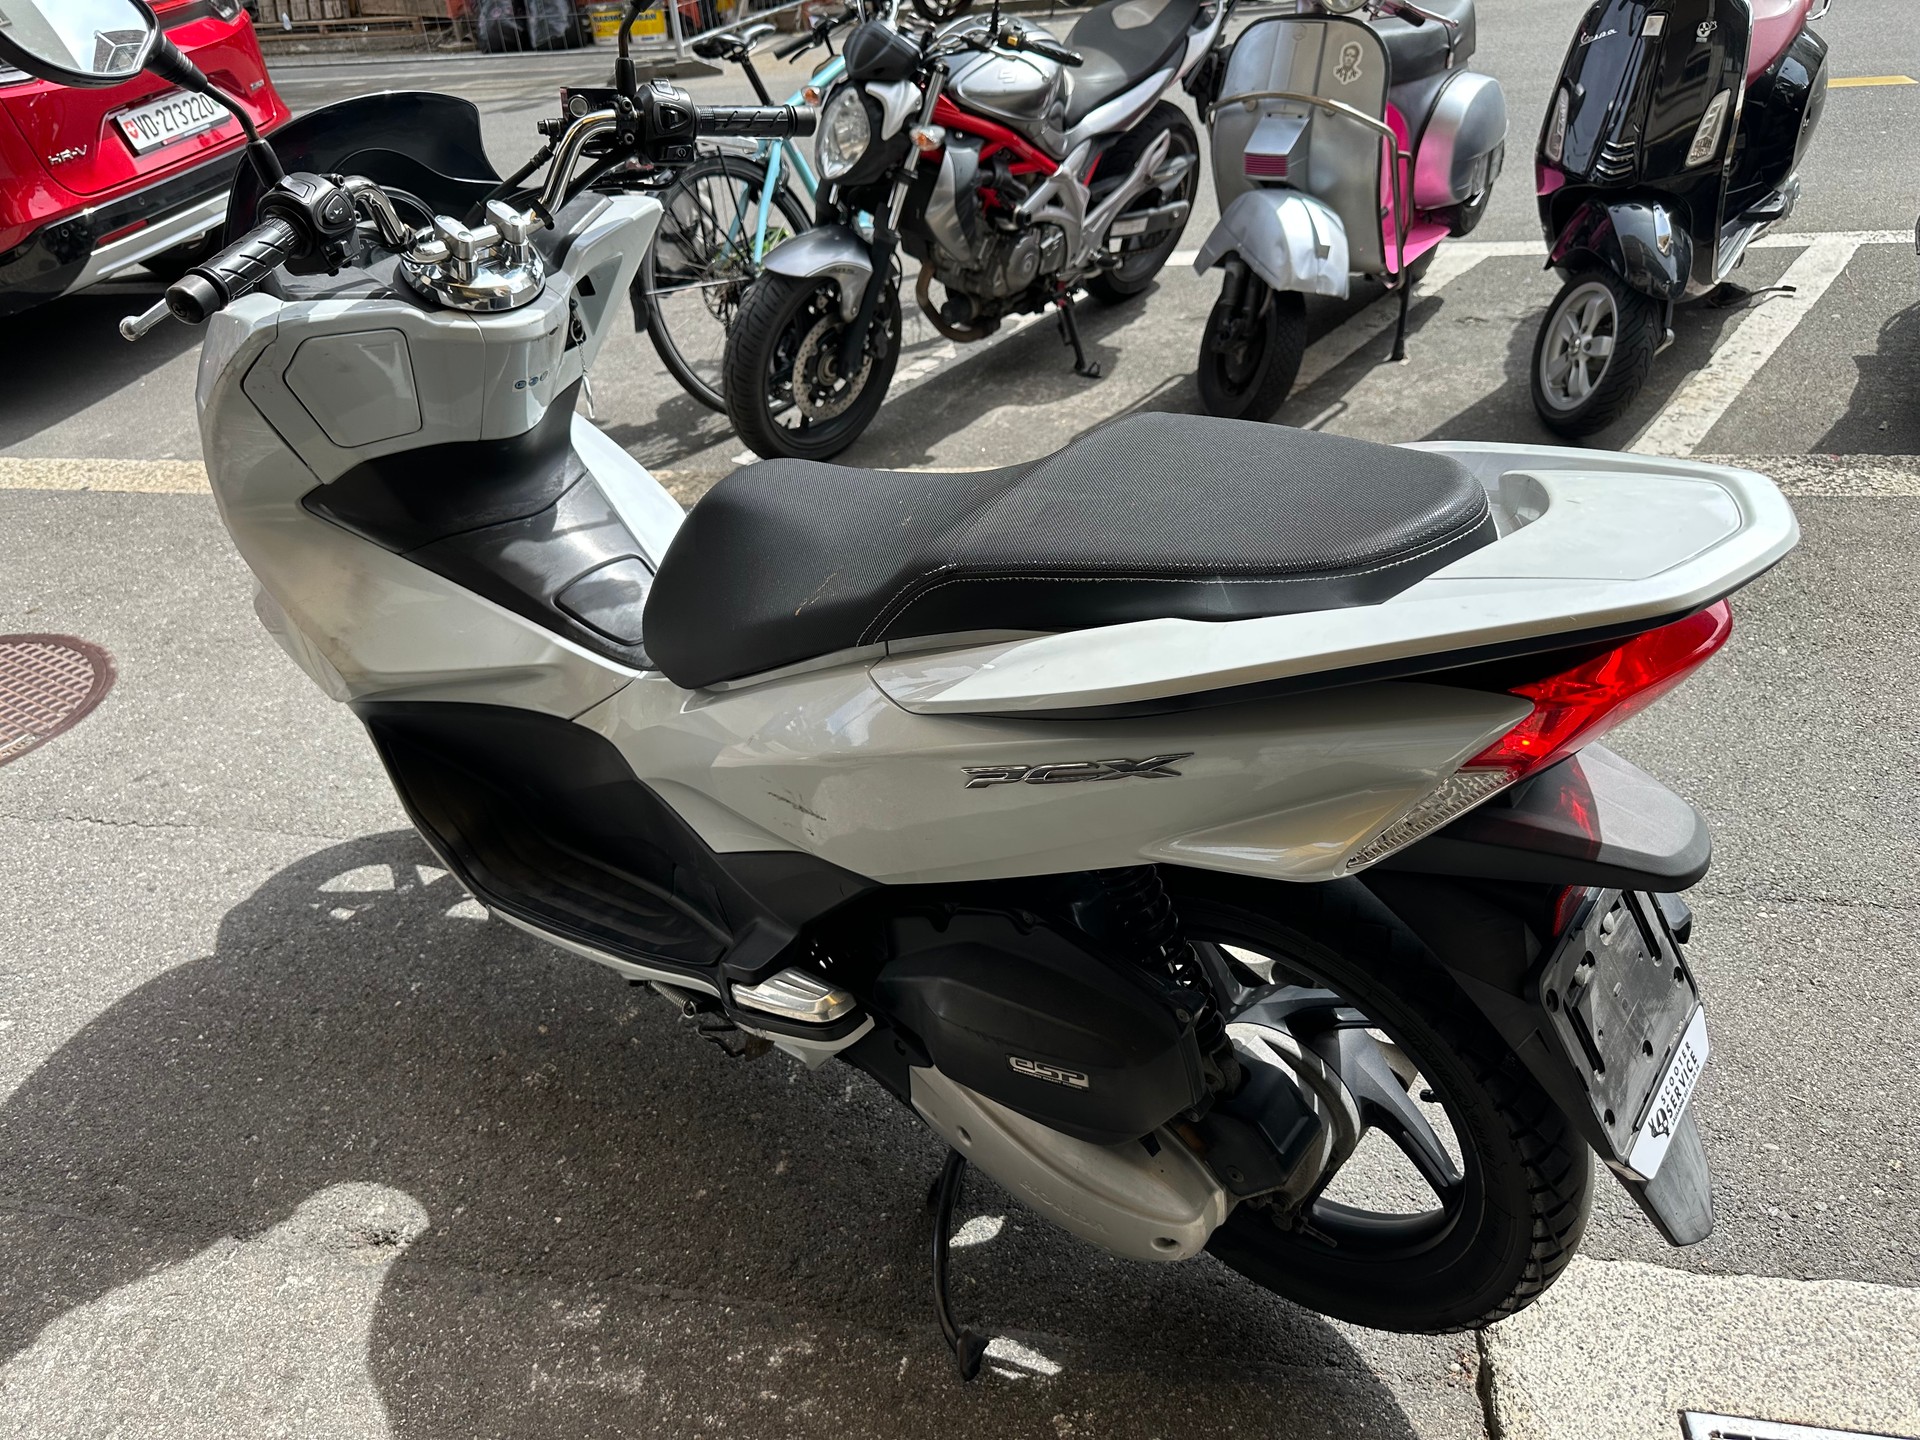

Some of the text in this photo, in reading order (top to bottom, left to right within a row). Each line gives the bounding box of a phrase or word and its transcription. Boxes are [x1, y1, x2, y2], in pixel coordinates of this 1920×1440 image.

[47, 143, 88, 166] HR-V
[960, 751, 1195, 789] PCX
[1660, 1041, 1691, 1105] SCOOTER
[1665, 1050, 1698, 1119] SERVICE
